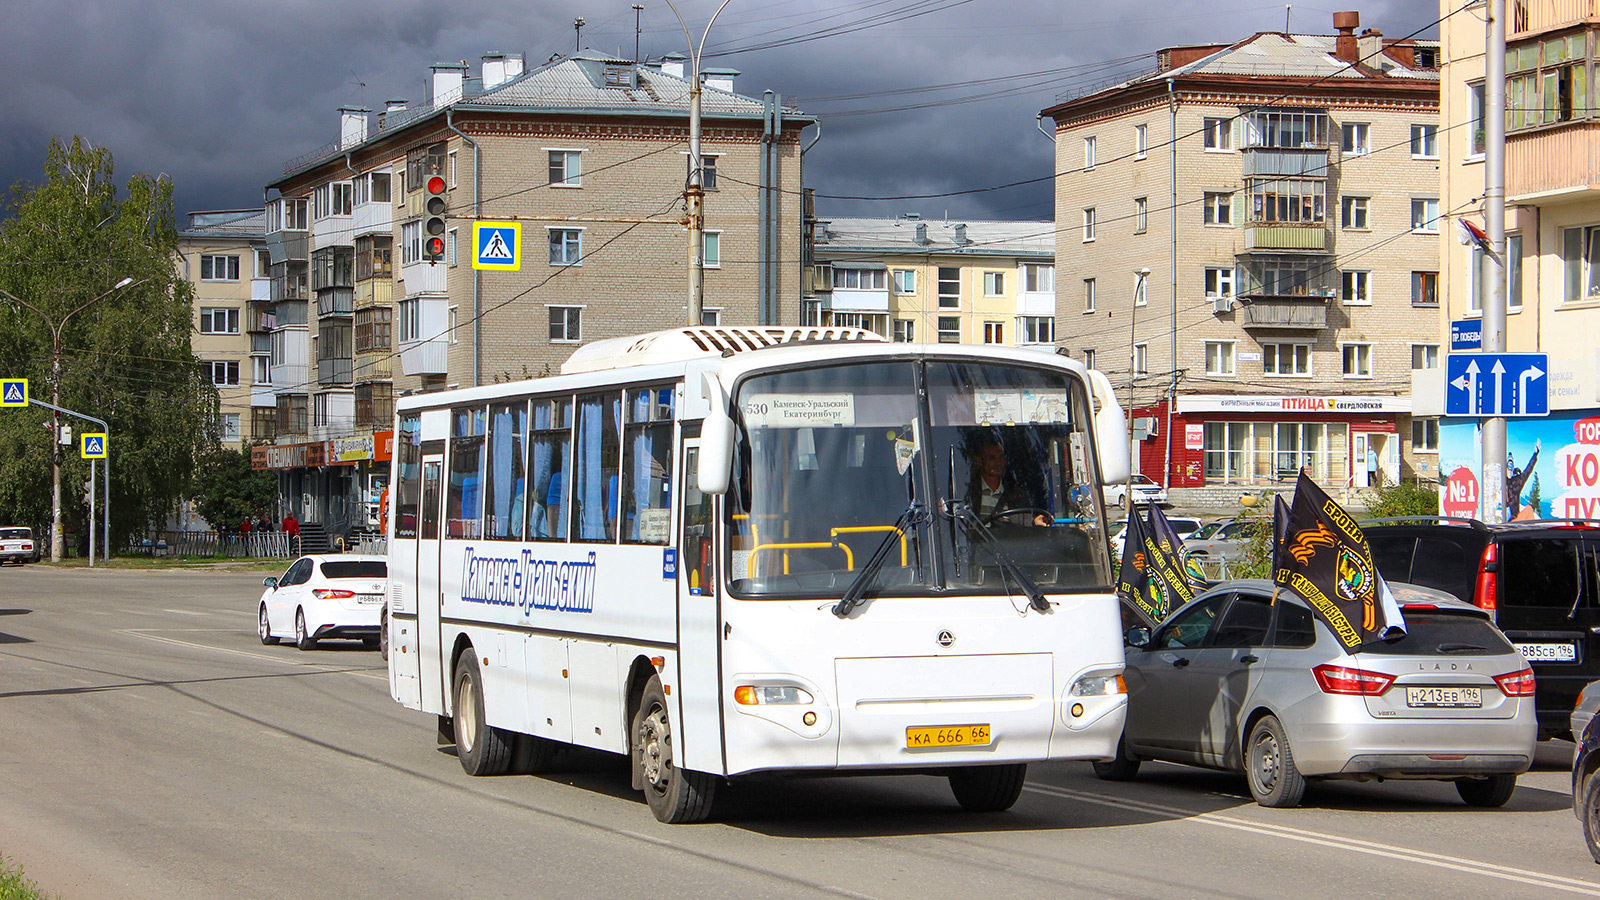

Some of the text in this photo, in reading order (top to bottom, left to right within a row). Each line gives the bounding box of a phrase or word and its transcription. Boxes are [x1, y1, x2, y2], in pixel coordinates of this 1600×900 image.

[433, 238, 442, 253] 9
[1452, 331, 1481, 343] ПР. ПОБЕДЫ
[1557, 384, 1581, 396] семьи!
[747, 403, 769, 415] 530
[773, 399, 849, 409] Каменск-Уральский
[1282, 398, 1326, 411] ПТИЦА
[783, 410, 842, 419] Екатеринбург
[1566, 452, 1600, 487] КО
[1449, 480, 1476, 503] №1
[1565, 497, 1600, 526] ПУ
[1323, 499, 1364, 544] БРОНЯ
[1145, 536, 1167, 569] БРОНЯ
[461, 546, 597, 617] Каменск-Уральский
[1276, 568, 1290, 583] И
[1324, 606, 1363, 648] БЫСТРЫ!
[1557, 645, 1573, 654] 196
[1419, 663, 1473, 671] LADA
[1411, 688, 1478, 703] Н213ЕВ 196
[914, 727, 985, 744] КА 666 66
